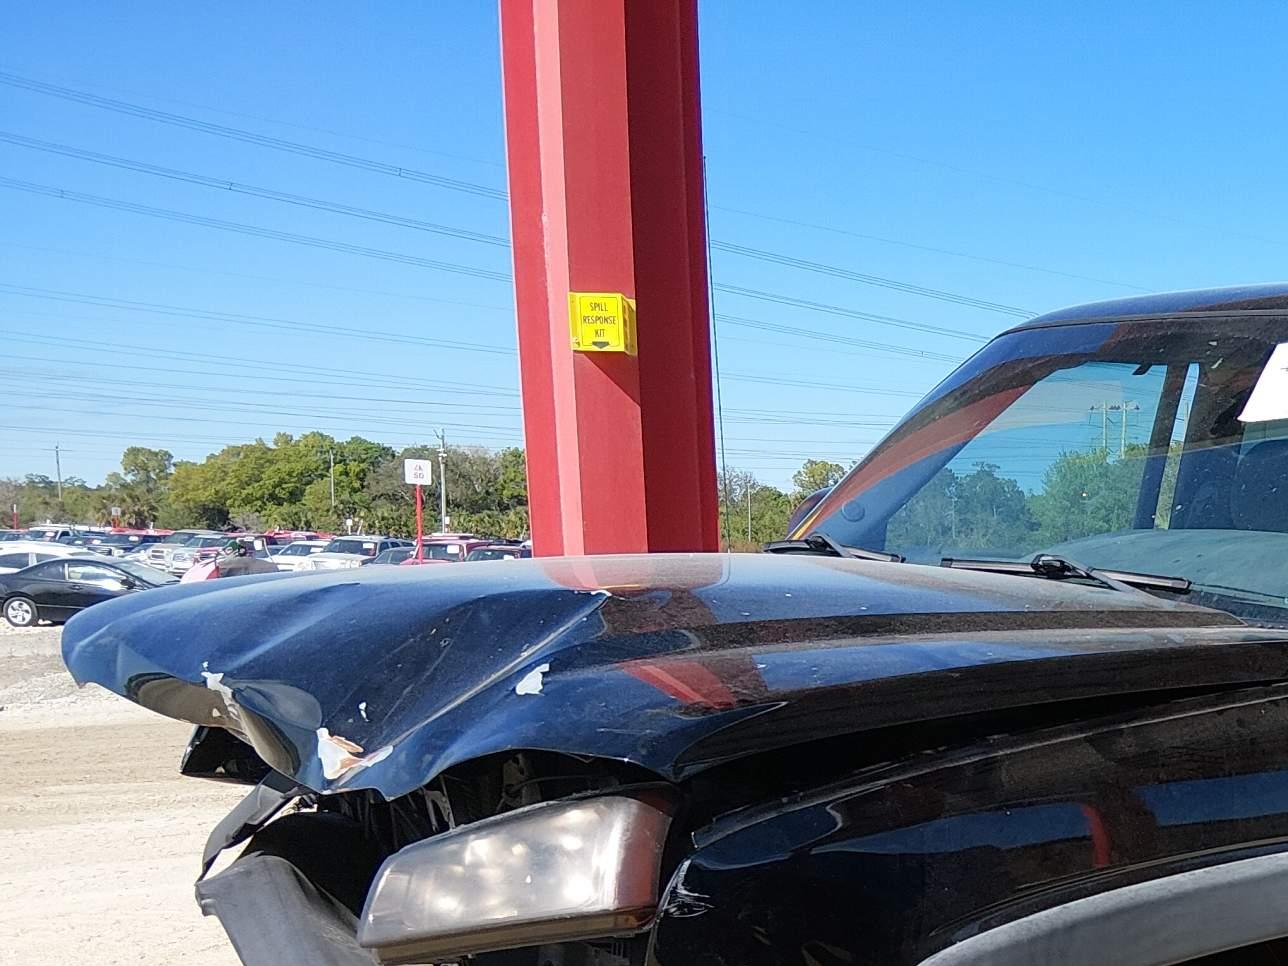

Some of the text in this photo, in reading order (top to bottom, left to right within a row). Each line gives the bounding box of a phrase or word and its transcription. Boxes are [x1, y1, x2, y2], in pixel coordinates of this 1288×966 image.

[589, 302, 608, 312] SPILL
[582, 315, 617, 325] RESPONSE
[594, 328, 605, 338] KIT
